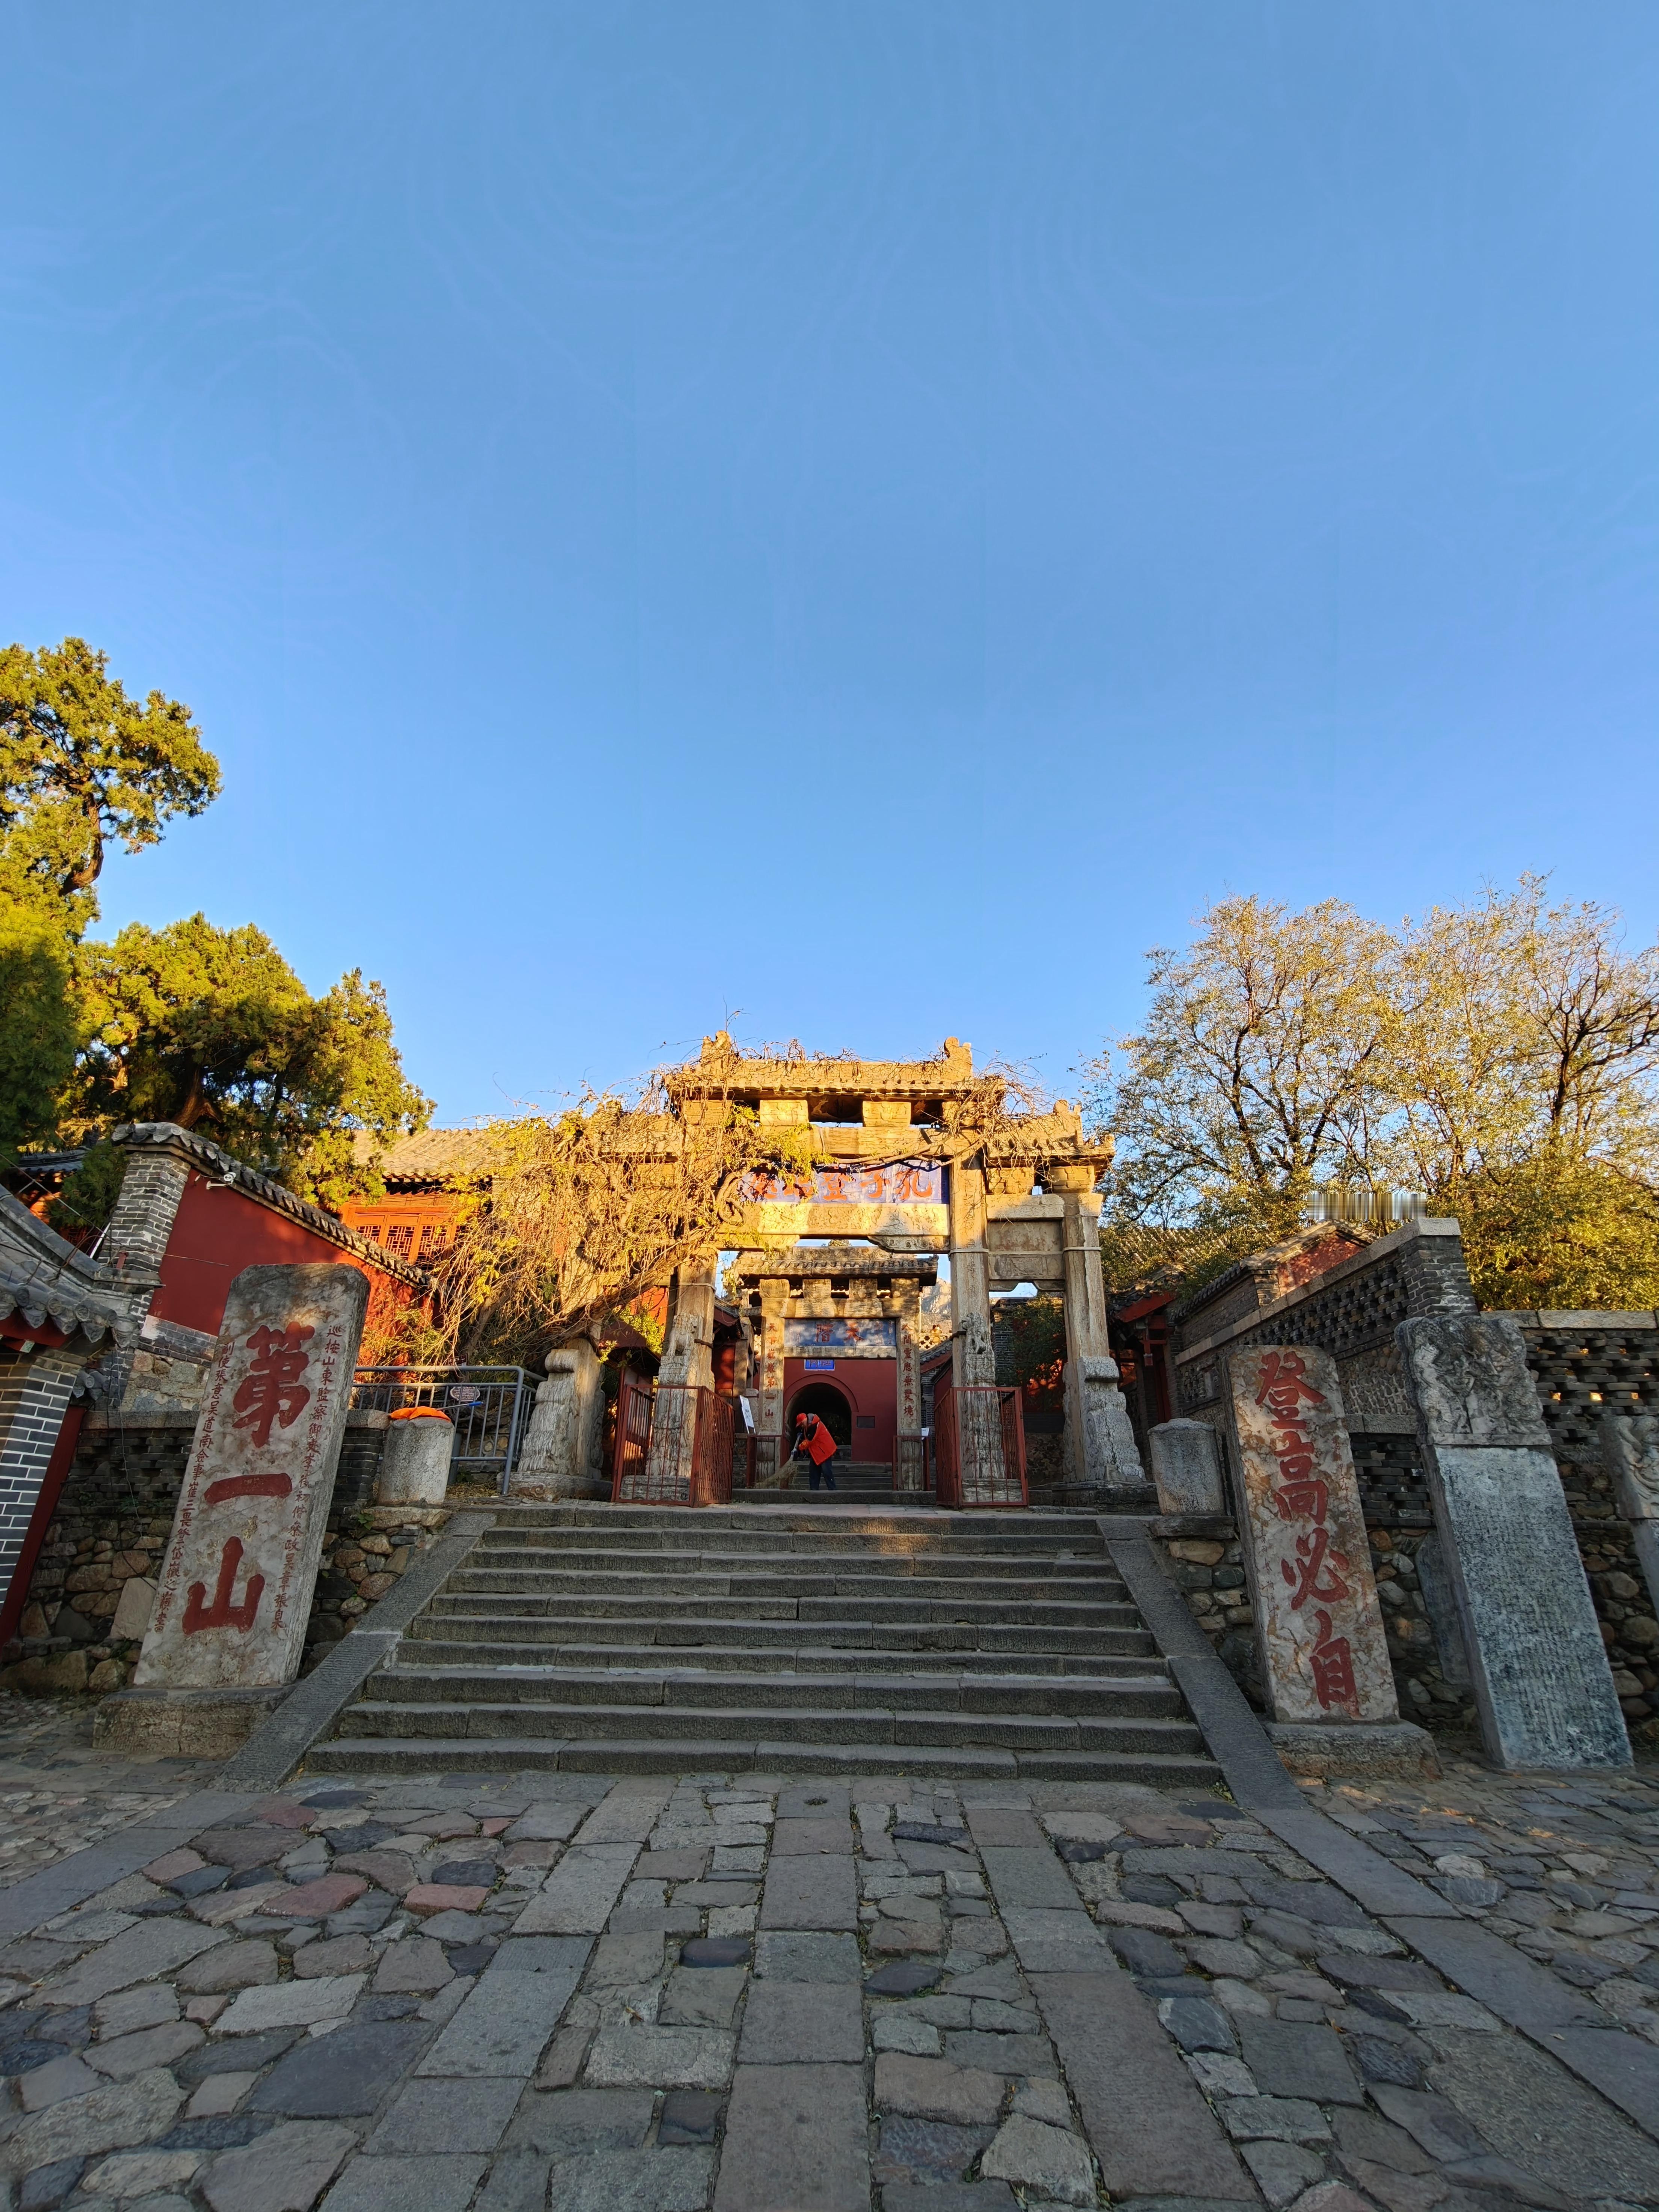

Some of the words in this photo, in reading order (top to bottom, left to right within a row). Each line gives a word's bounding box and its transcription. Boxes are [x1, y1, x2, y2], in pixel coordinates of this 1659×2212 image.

[181, 1321, 316, 1634] 第一山
[1255, 1350, 1360, 1719] 登高必自
